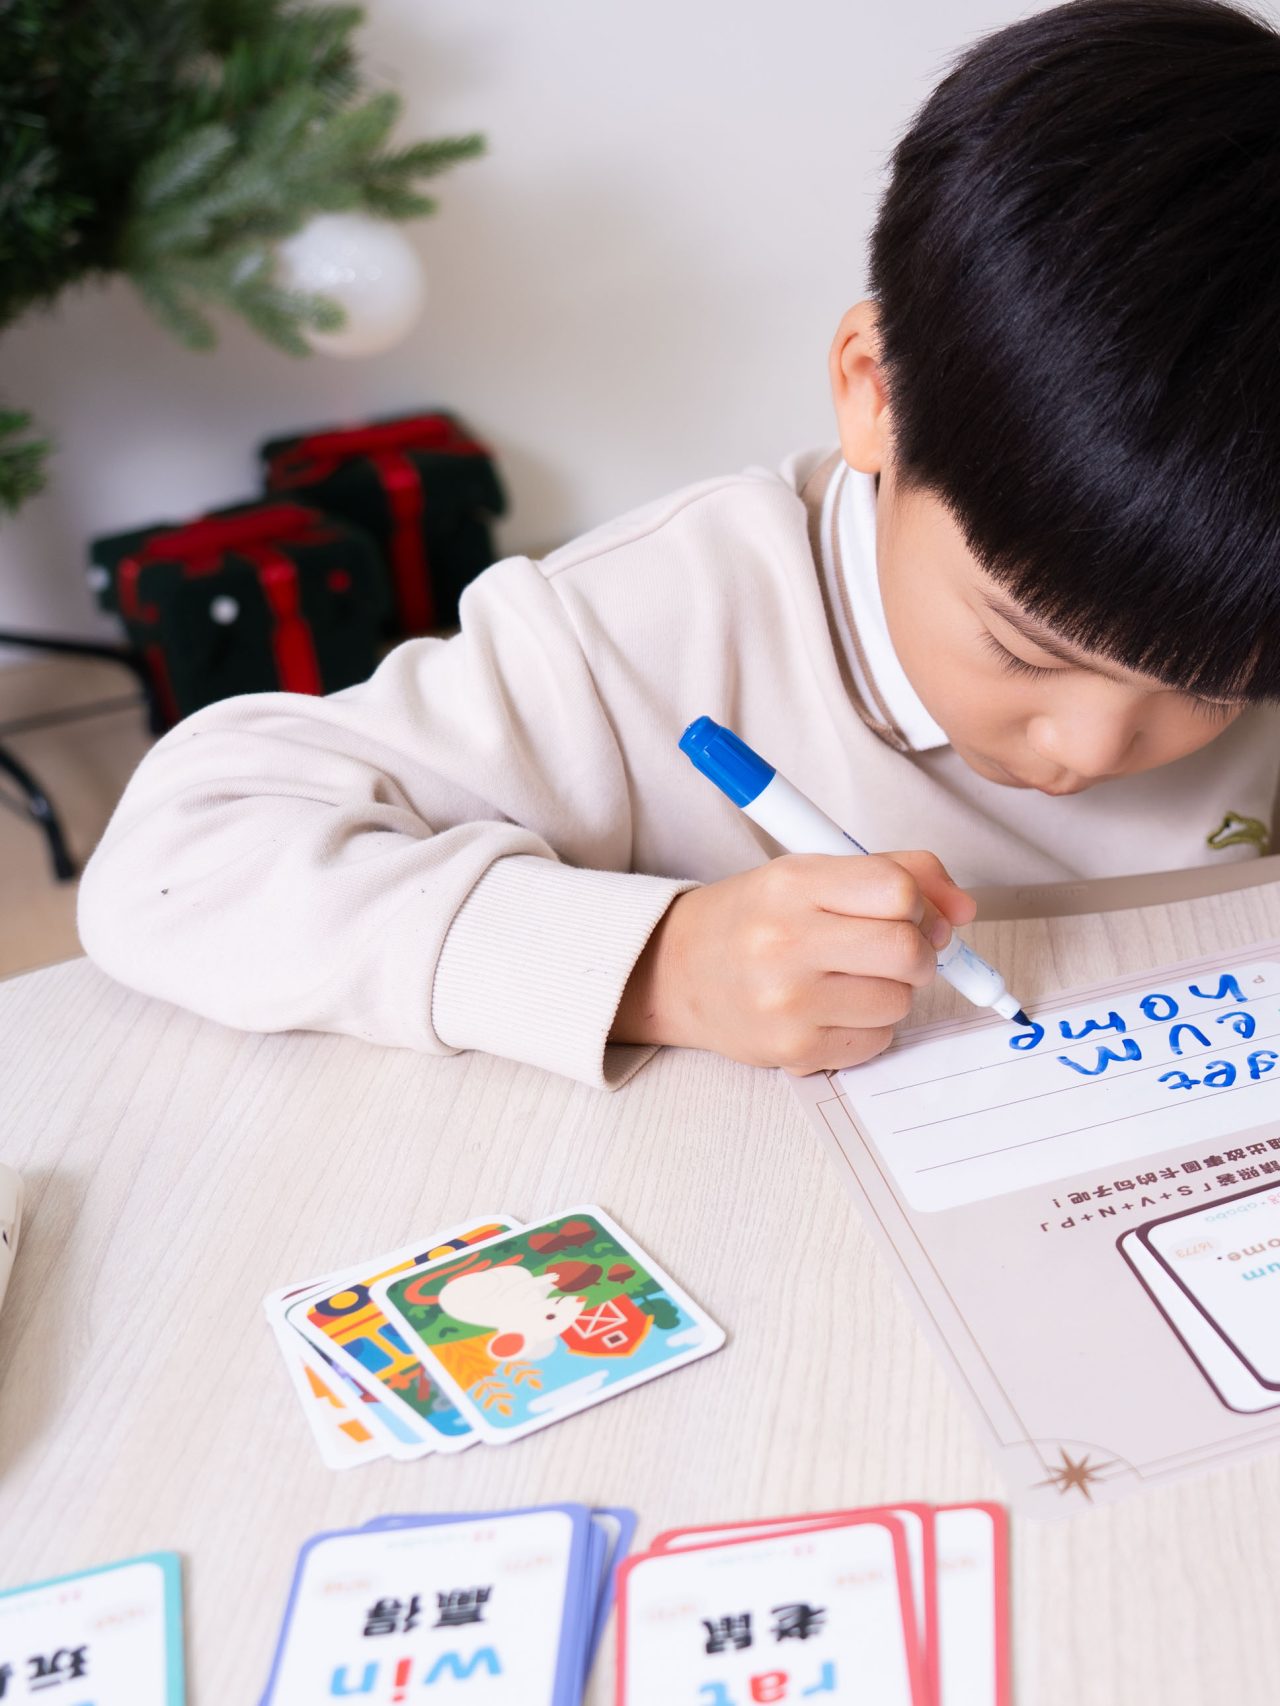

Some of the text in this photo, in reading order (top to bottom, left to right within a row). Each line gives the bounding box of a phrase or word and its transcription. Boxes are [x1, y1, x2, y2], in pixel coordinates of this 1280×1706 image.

[1252, 974, 1264, 983] P
[1008, 973, 1248, 1050] home
[363, 1587, 491, 1637] 贏得
[702, 1604, 825, 1654] 老鼠
[329, 1646, 503, 1703] win
[699, 1662, 836, 1706] rat
